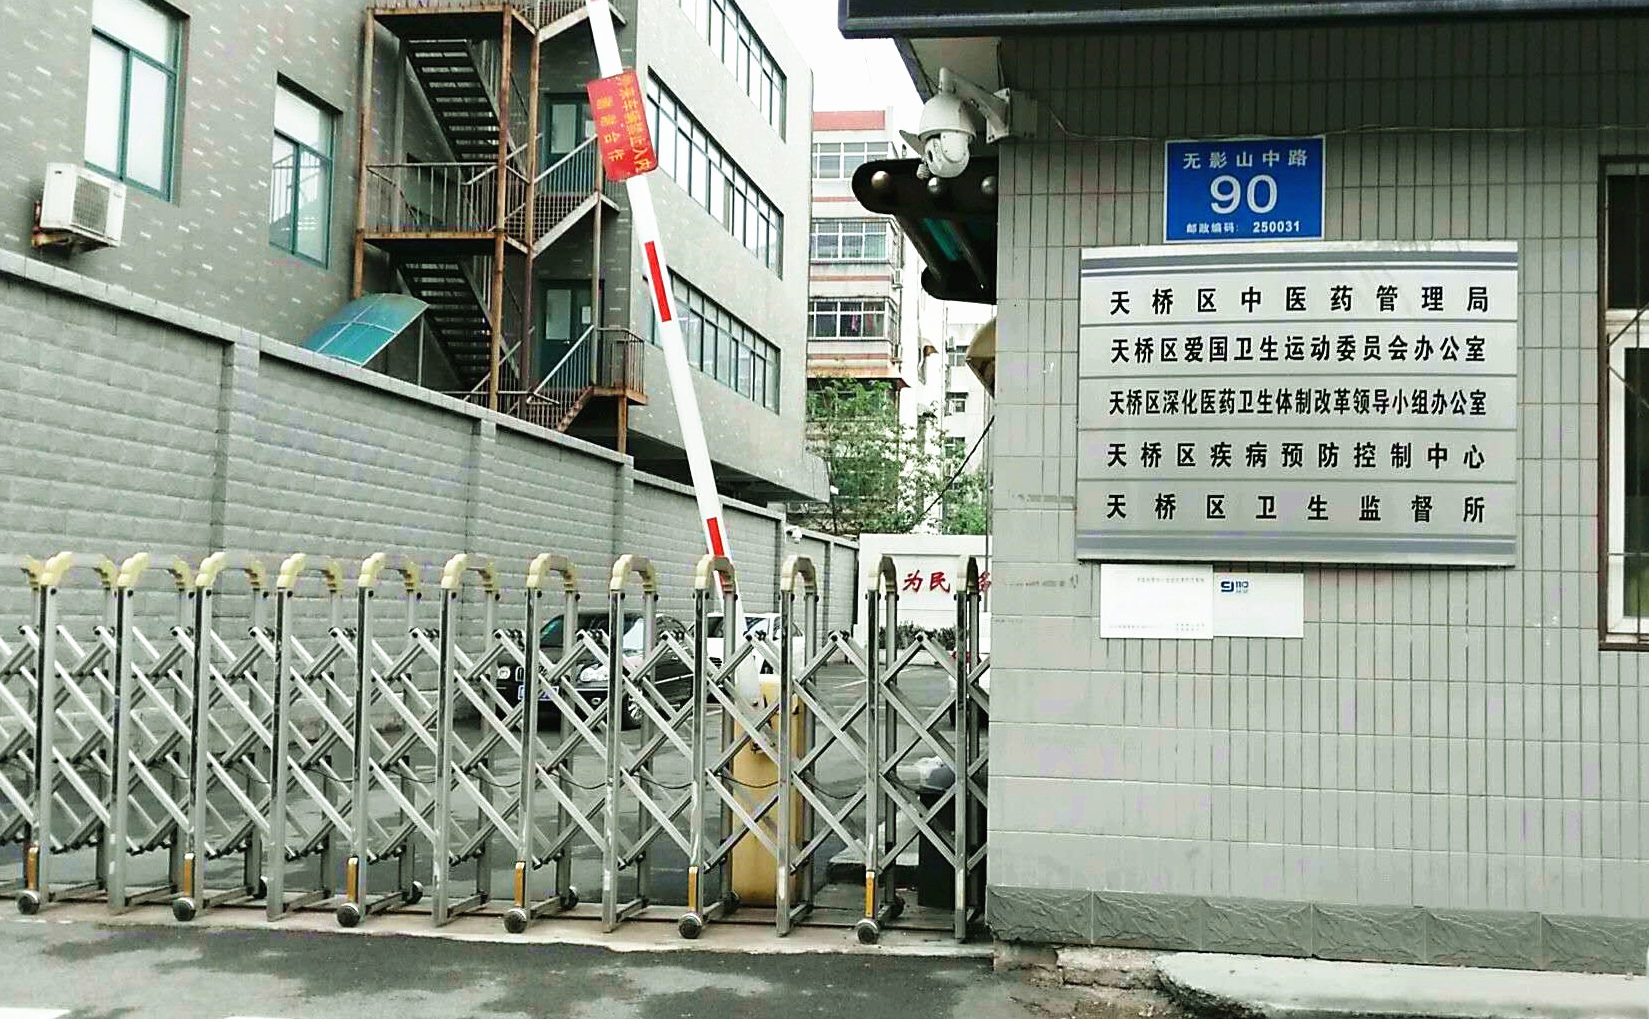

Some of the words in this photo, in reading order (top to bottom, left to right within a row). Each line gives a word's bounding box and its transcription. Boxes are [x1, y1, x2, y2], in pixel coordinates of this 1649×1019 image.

[1183, 149, 1308, 169] 无影山中路
[1210, 174, 1277, 214] 90
[1253, 220, 1300, 233] 250031
[1110, 285, 1488, 314] 天桥区中医药管理局
[1110, 335, 1486, 363] 天桥区爱国卫生运动委员会办公室
[1109, 387, 1487, 417] 天桥区深化医药卫生体制改革领导小组办公室
[1107, 441, 1485, 469] 天桥区疾病预防控制中心
[1106, 493, 1485, 523] 天桥区卫生监督所
